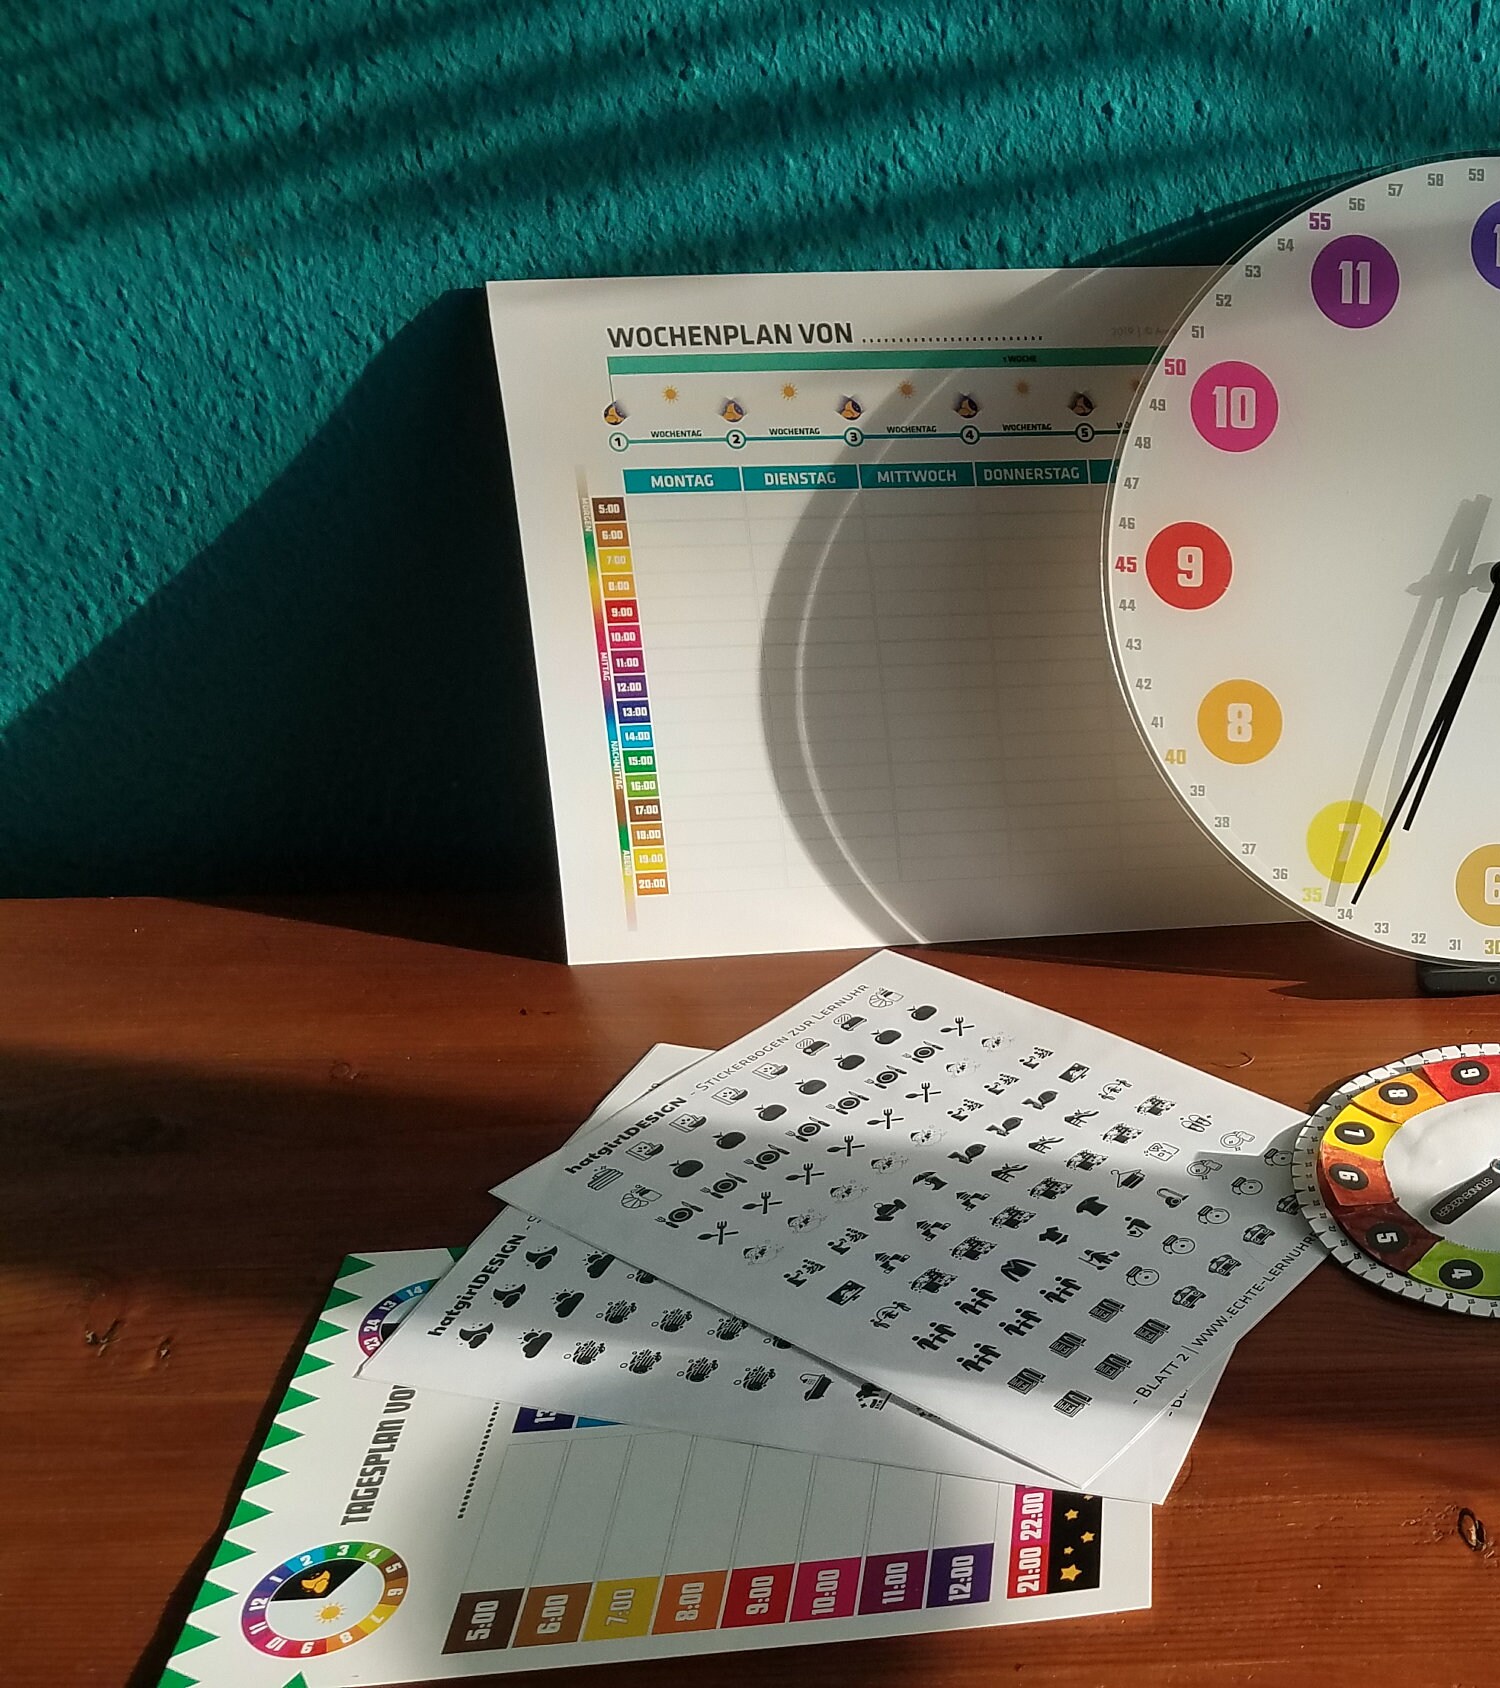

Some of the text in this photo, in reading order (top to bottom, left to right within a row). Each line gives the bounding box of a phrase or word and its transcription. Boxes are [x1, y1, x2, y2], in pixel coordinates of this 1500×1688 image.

[1427, 173, 1444, 186] 58
[1469, 168, 1484, 181] 59
[1388, 184, 1403, 197] 57
[1349, 198, 1365, 211] 56
[1309, 213, 1331, 230] 55
[1278, 239, 1294, 251] 54
[1245, 265, 1261, 278] 53
[1339, 261, 1370, 304] 11
[1216, 294, 1231, 307] 52
[607, 322, 853, 350] WOCHENPLAN VON
[1192, 326, 1204, 338] 51
[1164, 359, 1186, 375] 50
[1150, 399, 1166, 411] 49
[1213, 386, 1255, 428] 10
[650, 423, 1052, 438] WOCHENTAG WOCHENTAG WOCHENTAG WOCHENTAG
[1135, 436, 1151, 449] 48
[650, 466, 1080, 488] MONTAG DIENSTAG MITTWOCH DONNERSTAG
[1124, 477, 1139, 489] 47
[599, 504, 620, 514] 5:00
[1119, 517, 1135, 529] 46
[602, 530, 623, 540] 6:00
[1115, 557, 1137, 573] 45
[1177, 546, 1203, 587] 9
[612, 607, 632, 617] 9:00
[1119, 600, 1136, 612] 44
[611, 632, 635, 641] 10:00
[1126, 639, 1142, 651] 43
[616, 658, 639, 667] 11:00
[617, 683, 641, 692] 12:00
[1136, 678, 1152, 690] 42
[1152, 716, 1164, 728] 41
[1227, 703, 1253, 742] 8
[1165, 749, 1186, 764] 40
[1190, 785, 1205, 797] 39
[635, 805, 658, 815] 17:00
[1214, 817, 1229, 828] 38
[1242, 843, 1256, 855] 37
[1338, 824, 1361, 862] 7
[1273, 868, 1288, 880] 36
[639, 879, 665, 888] 20:00
[1302, 888, 1321, 902] 35
[1338, 909, 1353, 920] 34
[1374, 923, 1389, 934] 33
[1411, 933, 1426, 944] 32
[1449, 939, 1461, 950] 31
[1460, 1066, 1479, 1079] 9
[565, 1097, 687, 1175] hatgirlDESIGN
[788, 1020, 815, 1038] ZUR
[1388, 1088, 1408, 1098] 8
[1344, 1128, 1365, 1138] 7
[1338, 1170, 1359, 1182] 6
[1376, 1232, 1397, 1243] 5
[1450, 1268, 1472, 1280] 4
[427, 1234, 527, 1337] hatgirlDESIGN
[379, 1301, 397, 1311] 13
[366, 1319, 381, 1332] 24
[1136, 1360, 1179, 1398] BLATT
[1177, 1353, 1189, 1362] 2
[340, 1385, 416, 1526] TAGESPLAN VO
[1021, 1491, 1044, 1541] 22:00
[337, 1545, 349, 1556] 3
[366, 1549, 381, 1559] 4
[300, 1555, 313, 1566] 2
[385, 1563, 402, 1573] 5
[1016, 1546, 1042, 1593] 21:00
[881, 1562, 910, 1605] 11:00
[948, 1555, 974, 1600] 12:00
[387, 1588, 403, 1596] 6
[746, 1575, 774, 1615] 9:00
[811, 1569, 840, 1614] 10:00
[249, 1598, 269, 1611] 12
[605, 1588, 635, 1625] 7:00
[675, 1582, 705, 1622] 8:00
[465, 1600, 499, 1641] 5:00
[536, 1594, 569, 1635] 6:00
[301, 1642, 314, 1653] 9
